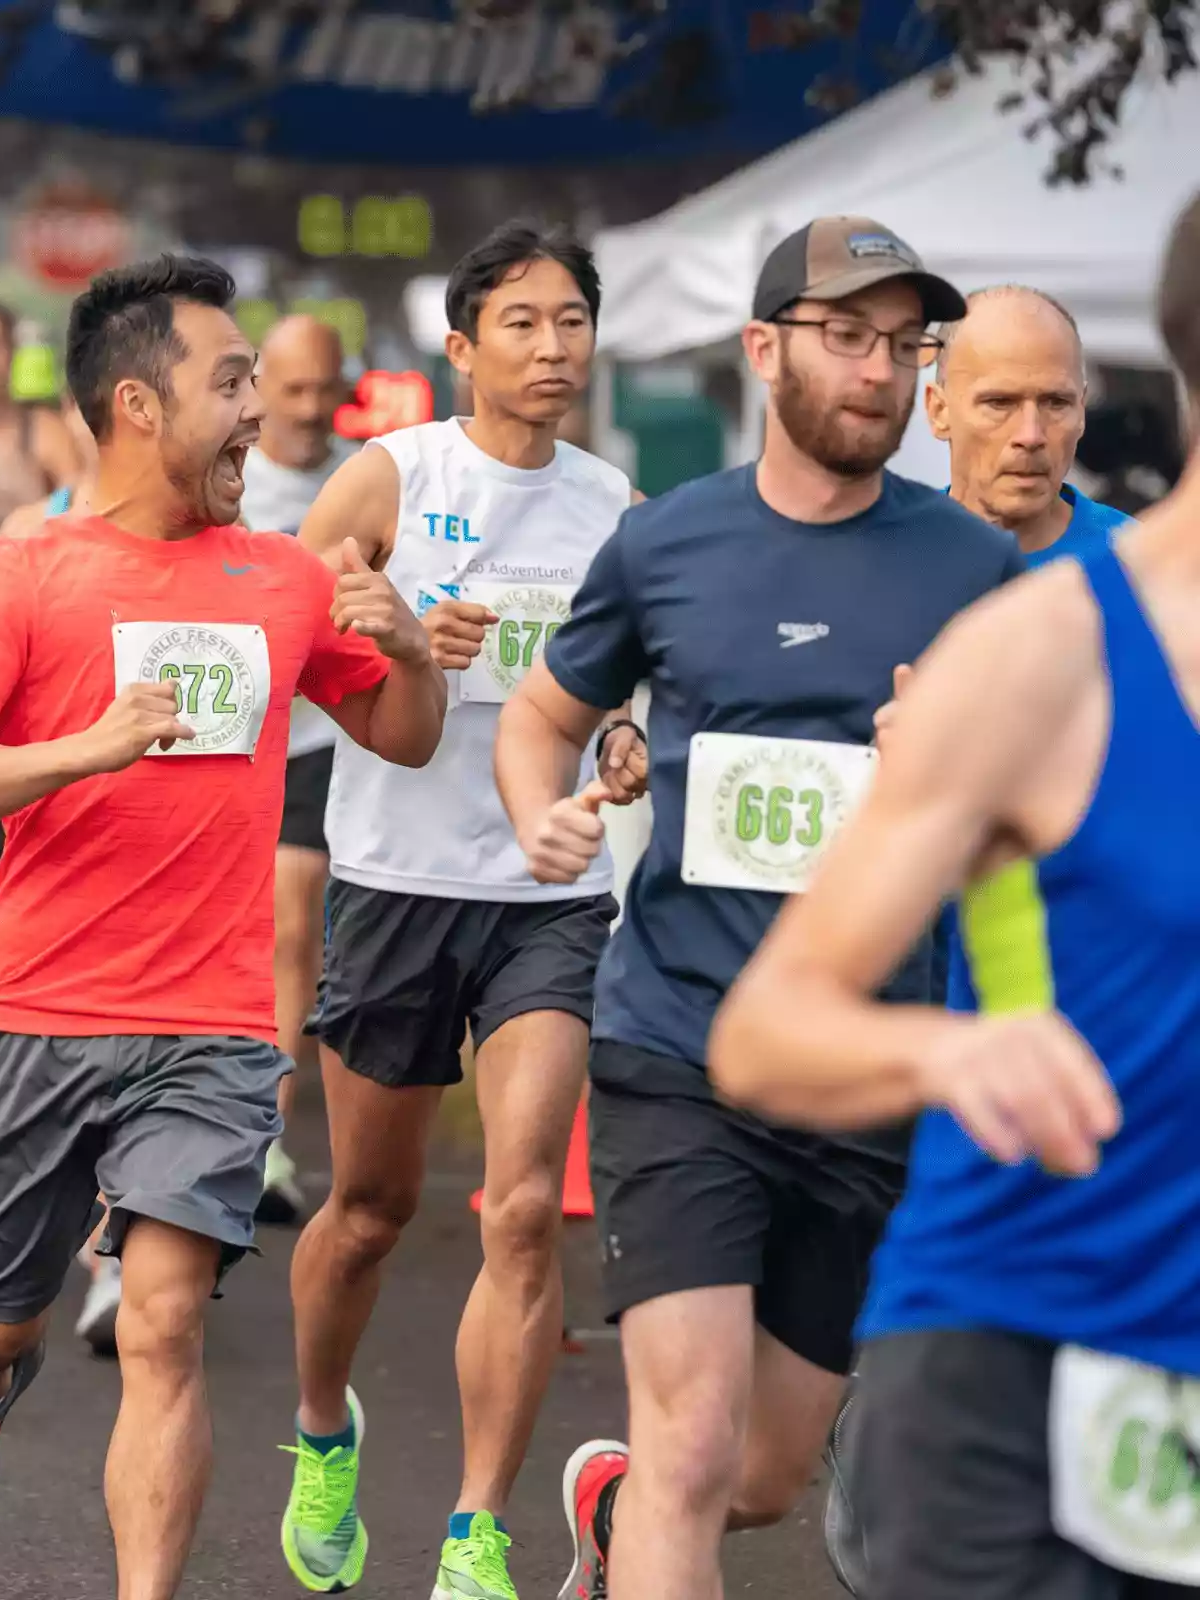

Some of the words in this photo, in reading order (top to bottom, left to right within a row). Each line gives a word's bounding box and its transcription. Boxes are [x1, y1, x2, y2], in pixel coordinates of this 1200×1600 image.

[422, 513, 481, 543] TEL
[488, 561, 574, 580] Adventure!
[142, 631, 182, 679] GARLIC
[187, 629, 250, 680] FESTIVAL
[159, 663, 237, 714] 672
[212, 695, 252, 746] MARATHON
[735, 783, 824, 847] 663
